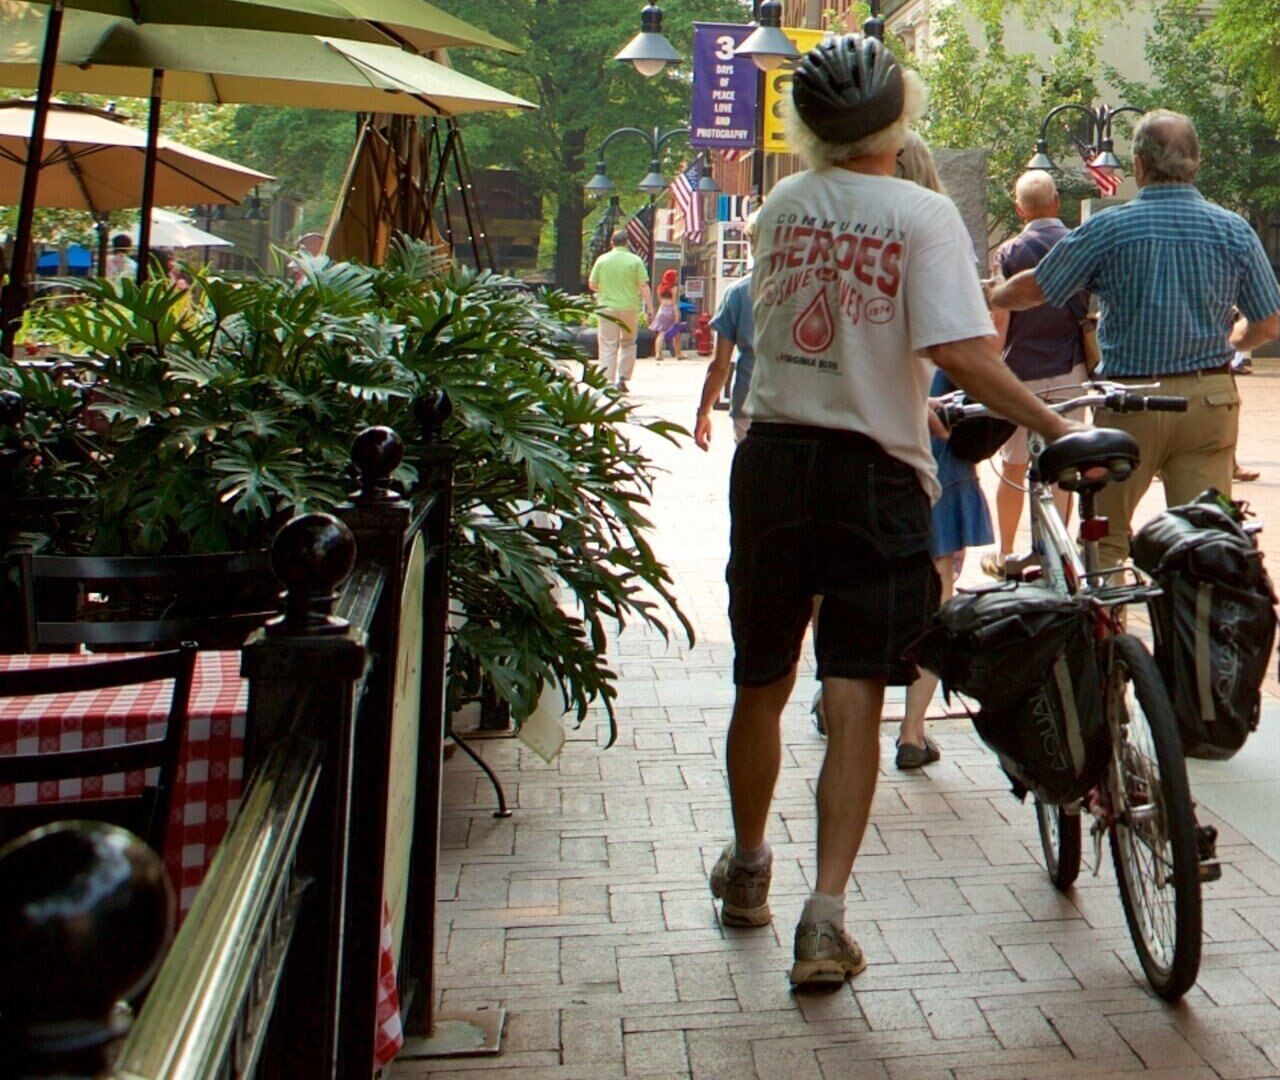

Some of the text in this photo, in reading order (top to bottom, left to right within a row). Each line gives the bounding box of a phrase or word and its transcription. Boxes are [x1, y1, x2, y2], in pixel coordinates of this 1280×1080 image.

[715, 36, 736, 60] 3
[716, 64, 734, 75] DAYS
[712, 91, 735, 101] PEACE
[714, 103, 733, 114] LOVE
[697, 128, 748, 139] PHOTOGRAPHY
[777, 212, 906, 238] COMMUNITY
[770, 224, 904, 298] HEROES
[776, 267, 812, 306] SAVE
